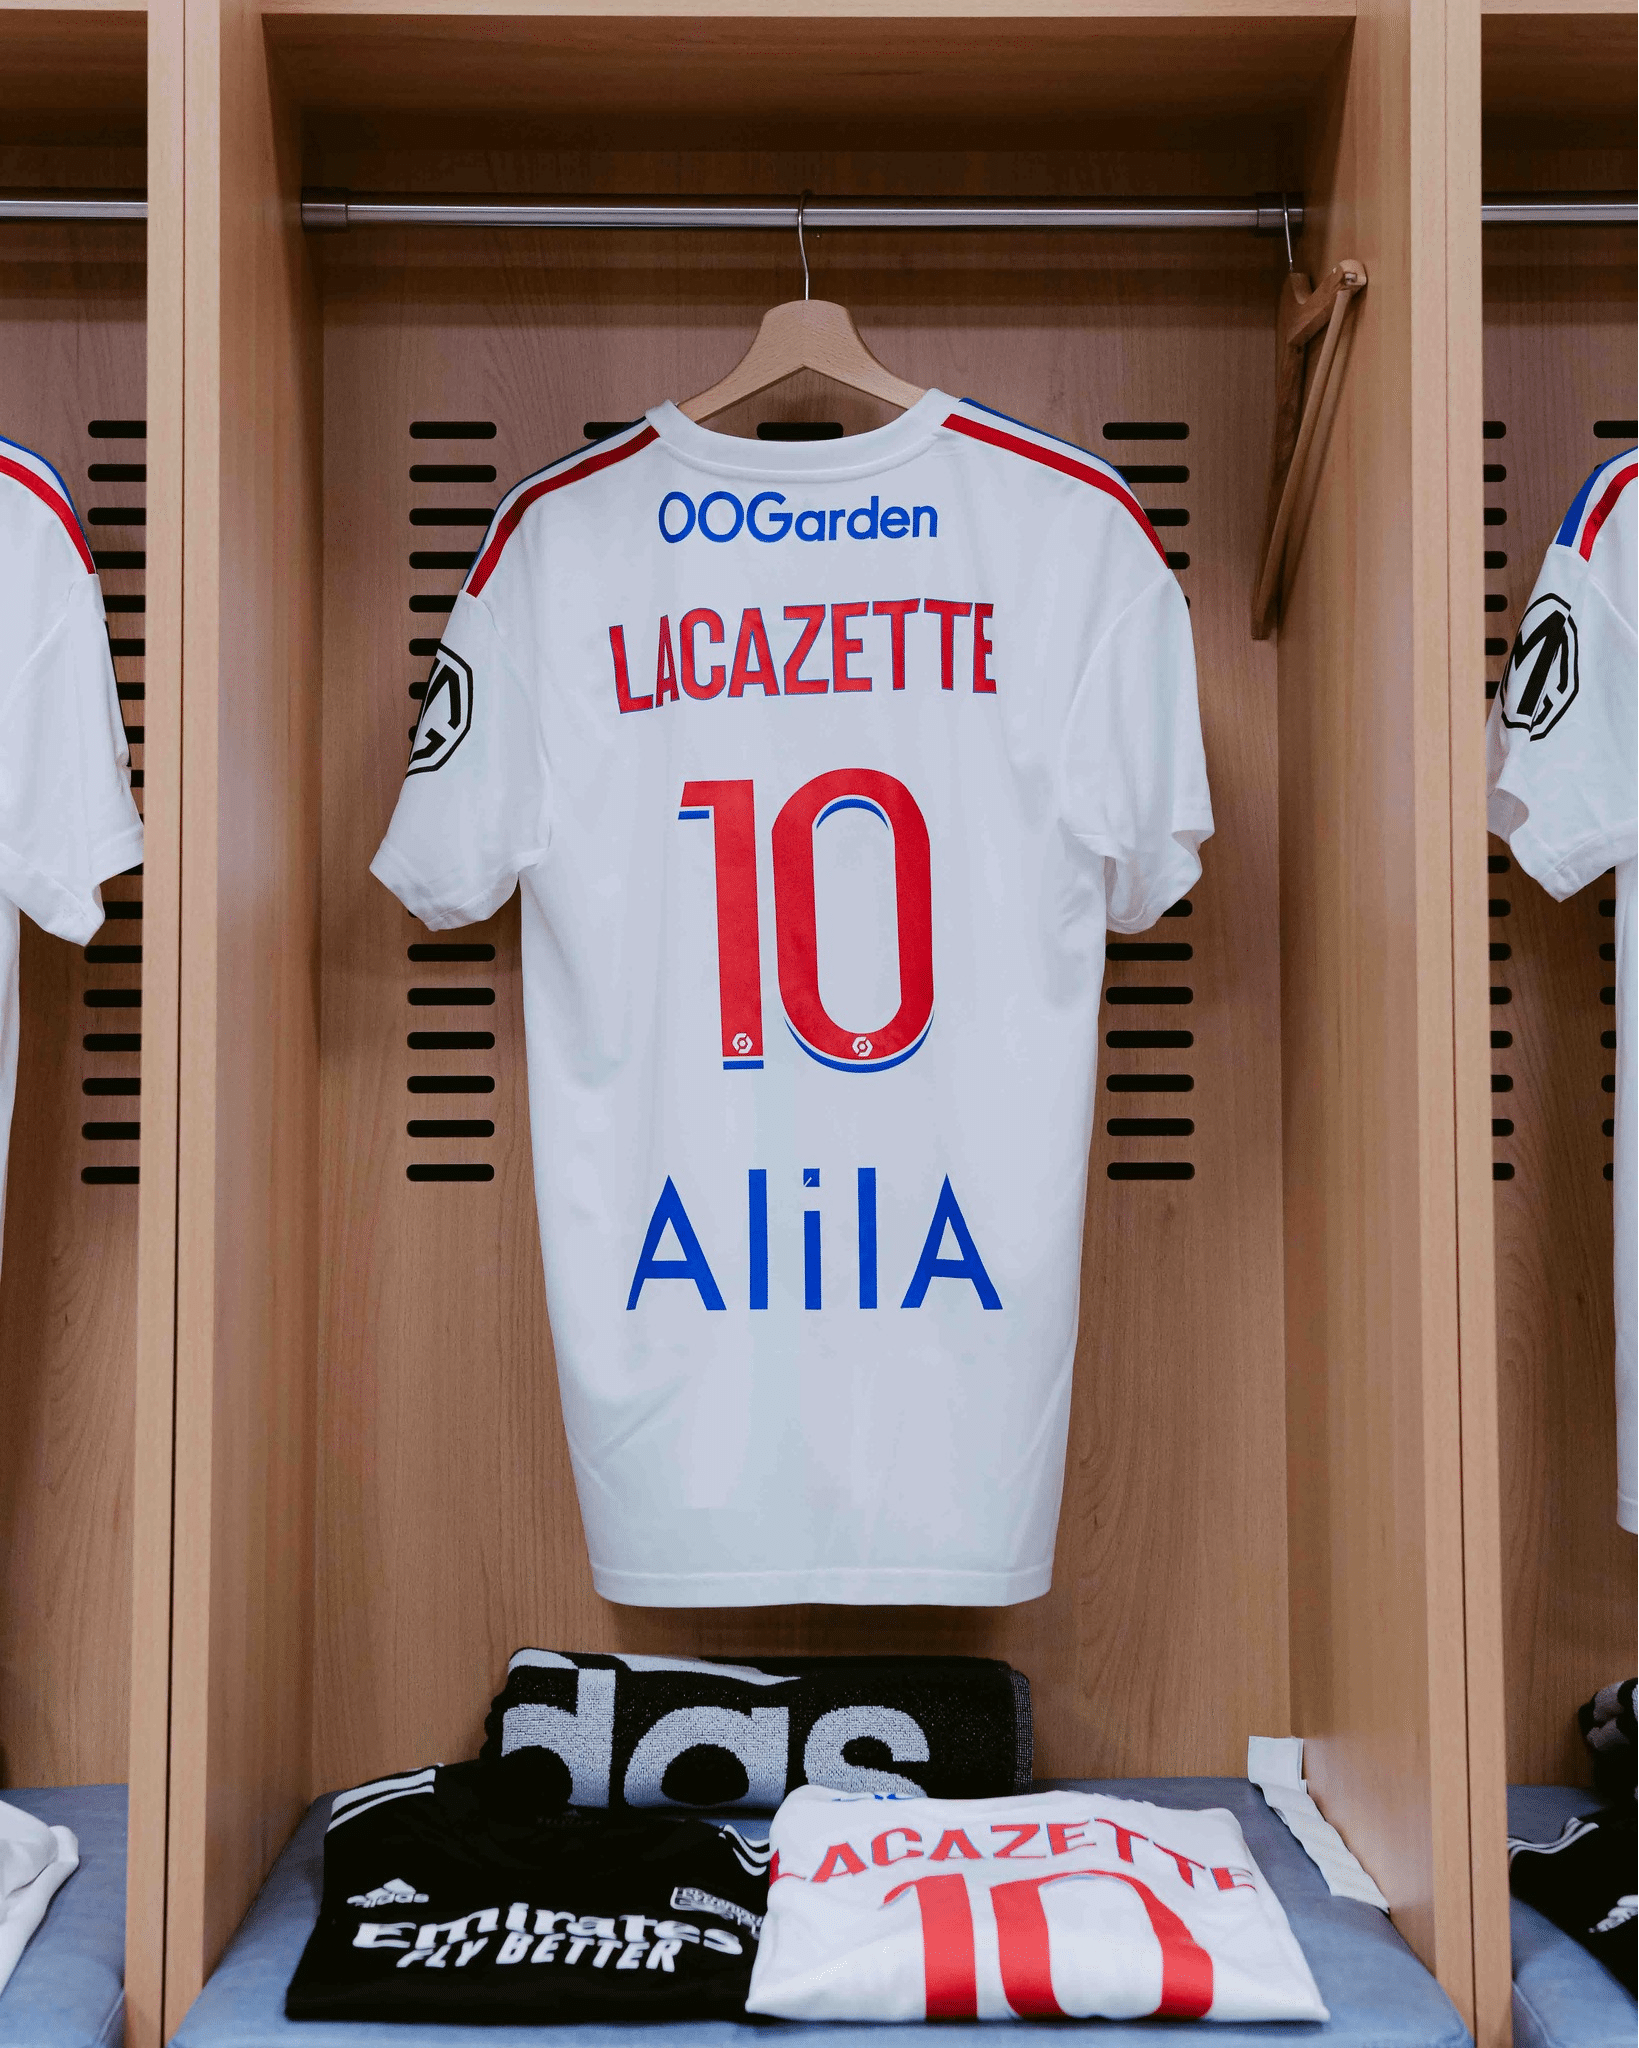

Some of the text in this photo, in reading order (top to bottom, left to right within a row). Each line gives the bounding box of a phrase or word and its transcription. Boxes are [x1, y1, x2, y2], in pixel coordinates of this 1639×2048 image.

[658, 491, 938, 543] OOGarden
[609, 598, 998, 714] LACAZETTE
[678, 768, 935, 1073] 10
[352, 1902, 743, 1955] Emirates
[396, 1931, 683, 1973] FLY BETTER
[880, 1869, 1214, 2020] 10
